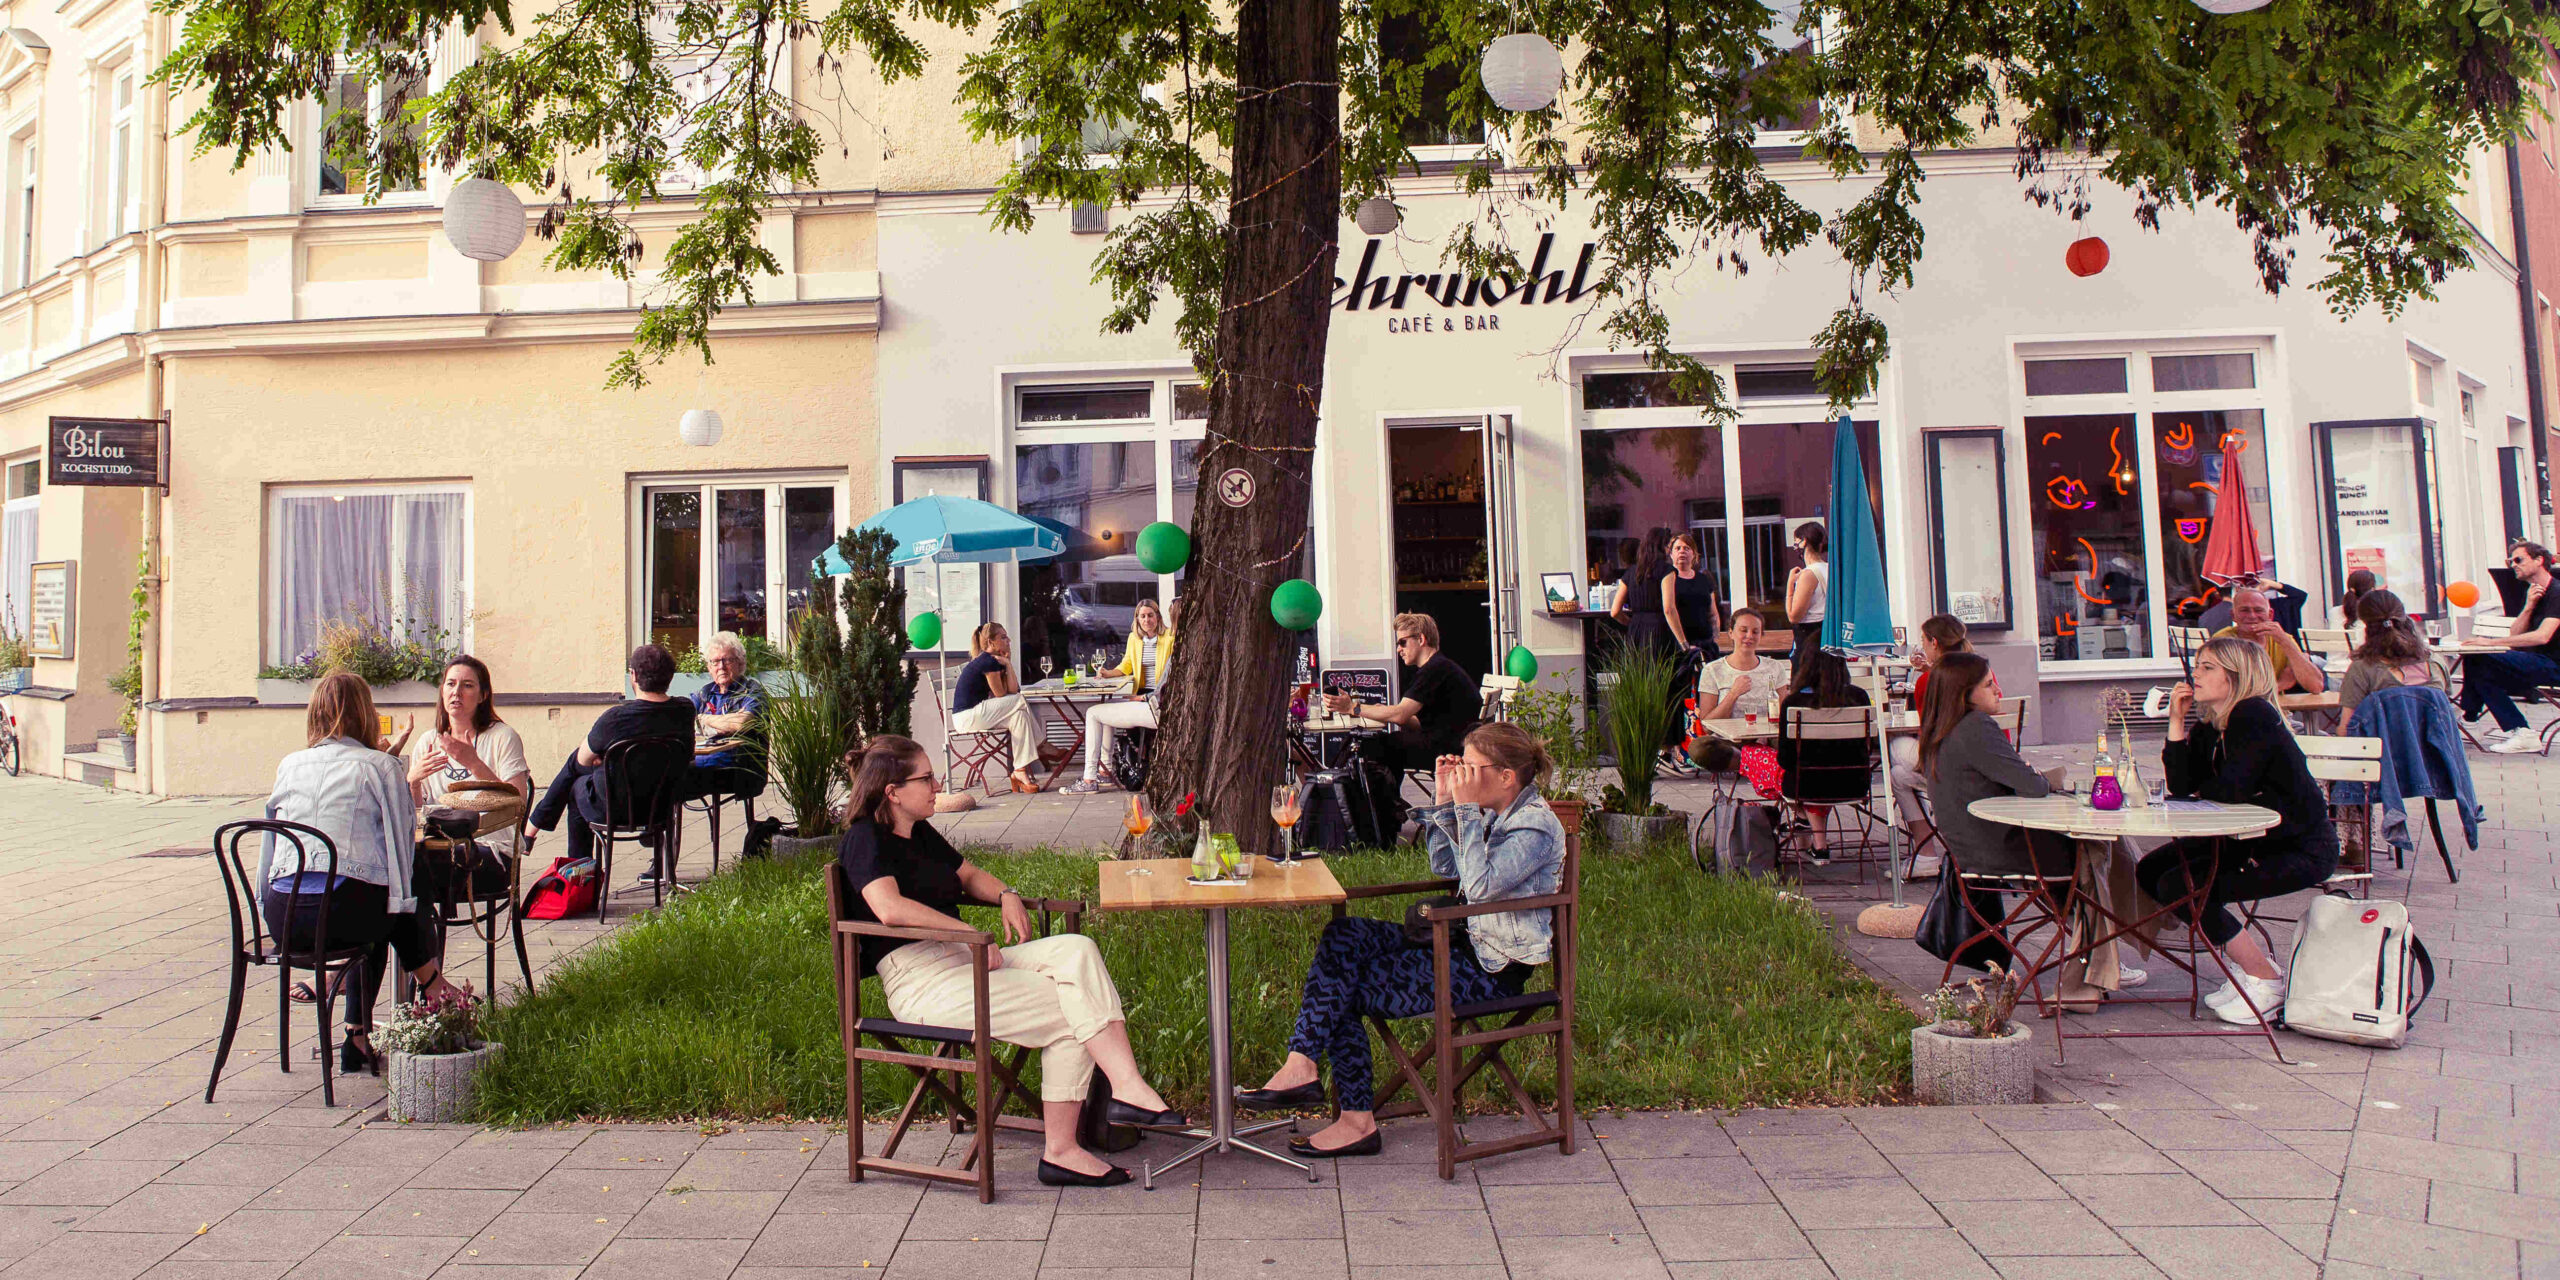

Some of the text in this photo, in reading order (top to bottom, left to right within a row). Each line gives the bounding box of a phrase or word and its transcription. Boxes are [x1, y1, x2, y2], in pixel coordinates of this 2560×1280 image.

[1388, 313, 1500, 333] CAFÉ & BAR
[63, 425, 126, 459] Bilou
[60, 463, 133, 475] KOCHSTUDIO
[2338, 491, 2367, 499] BUNCH
[2337, 509, 2389, 517] CANDINAVIAN
